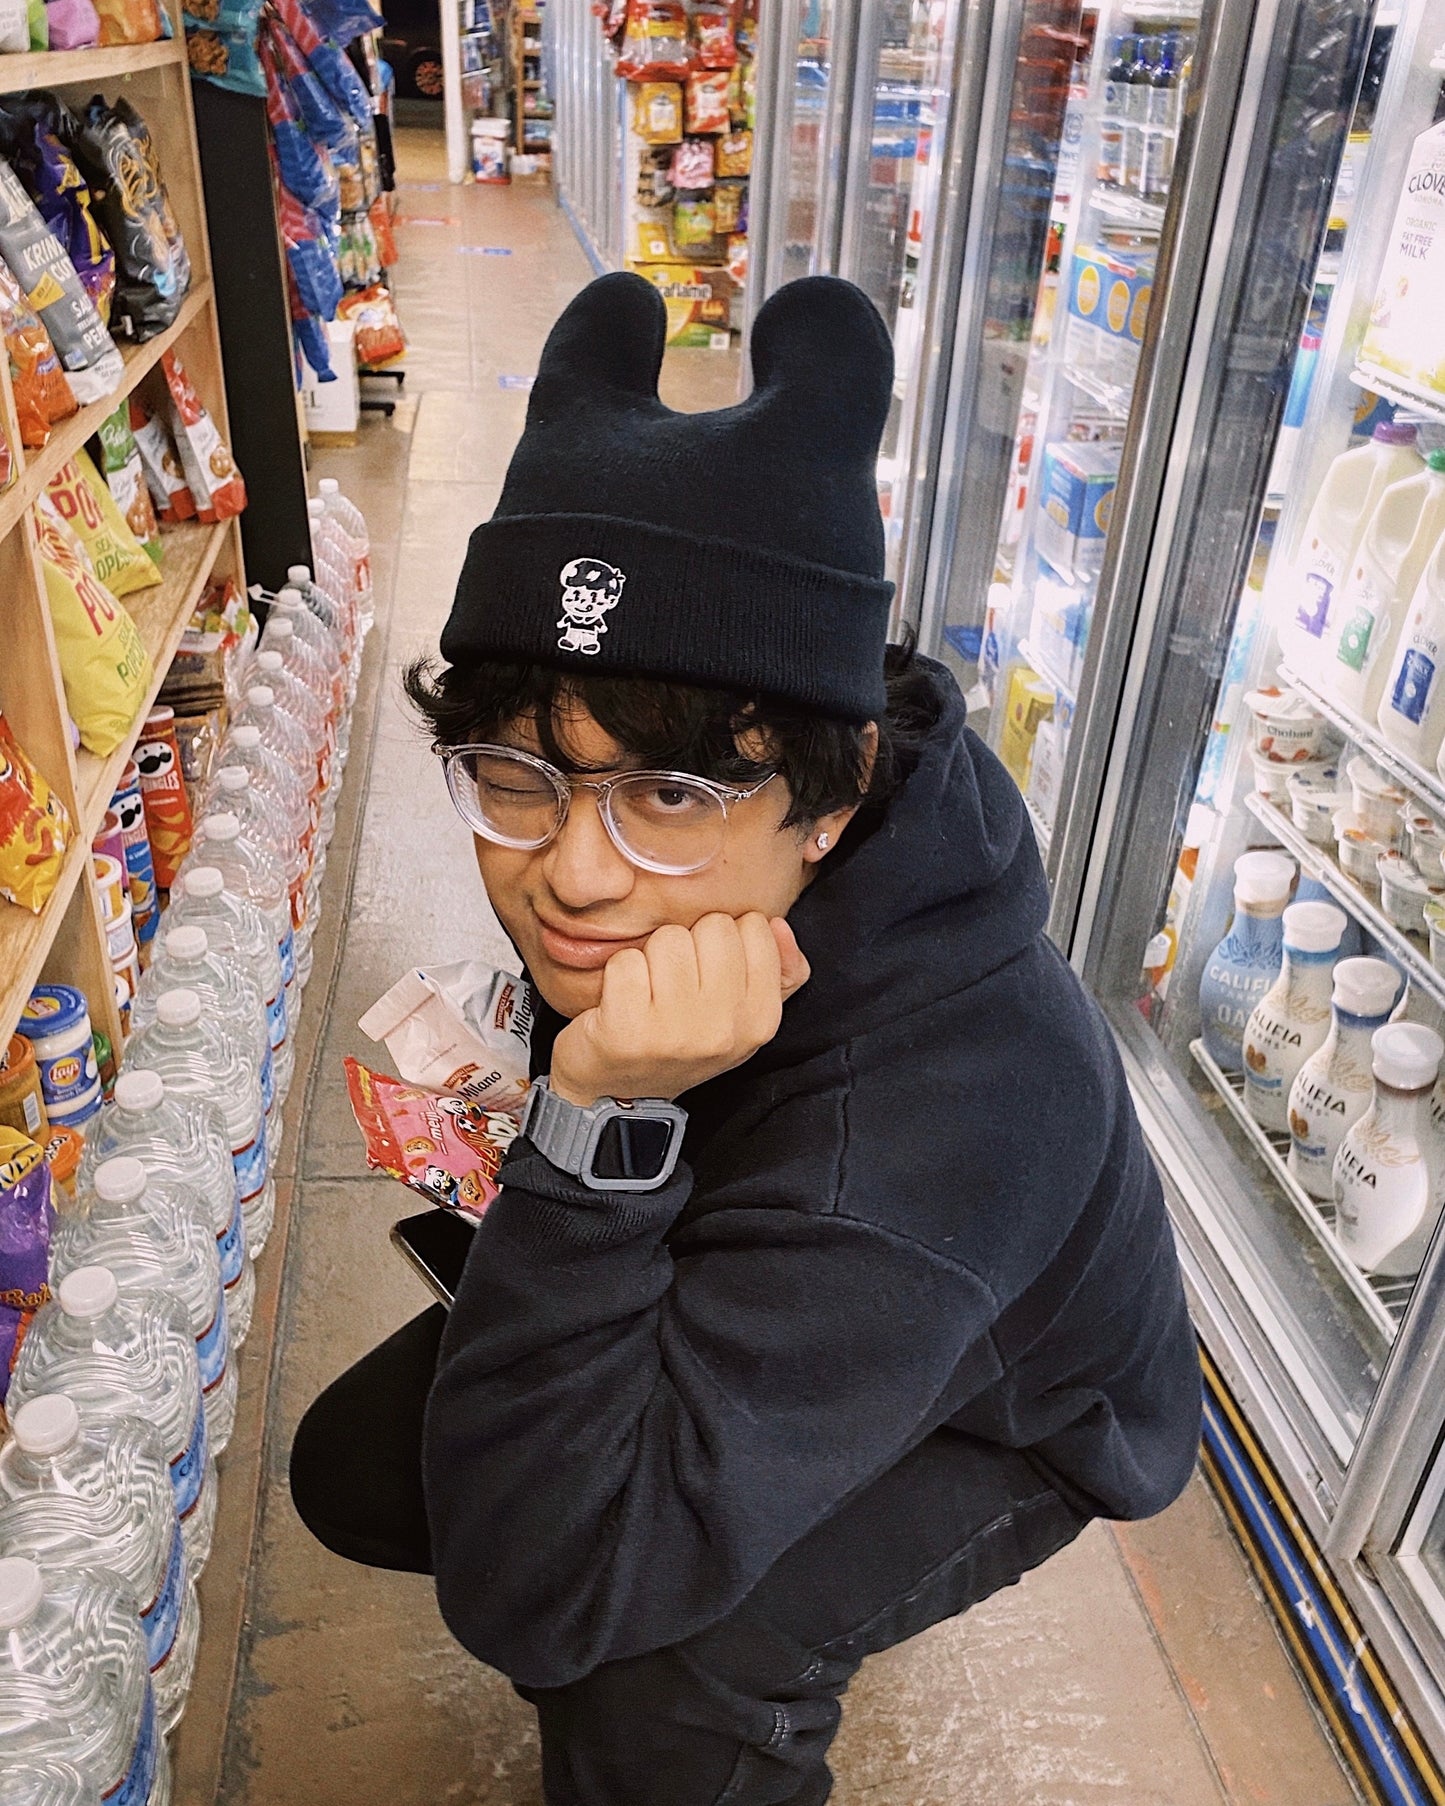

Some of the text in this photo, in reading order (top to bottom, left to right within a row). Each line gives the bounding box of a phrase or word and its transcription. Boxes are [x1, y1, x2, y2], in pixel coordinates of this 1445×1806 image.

[1405, 217, 1438, 232] ORGANIC
[1402, 231, 1434, 248] FAT FREE
[1400, 243, 1429, 261] MILK
[1266, 725, 1314, 739] Chobani
[52, 1061, 80, 1082] Lay's
[456, 1070, 502, 1101] Milano
[420, 1111, 445, 1142] meiji
